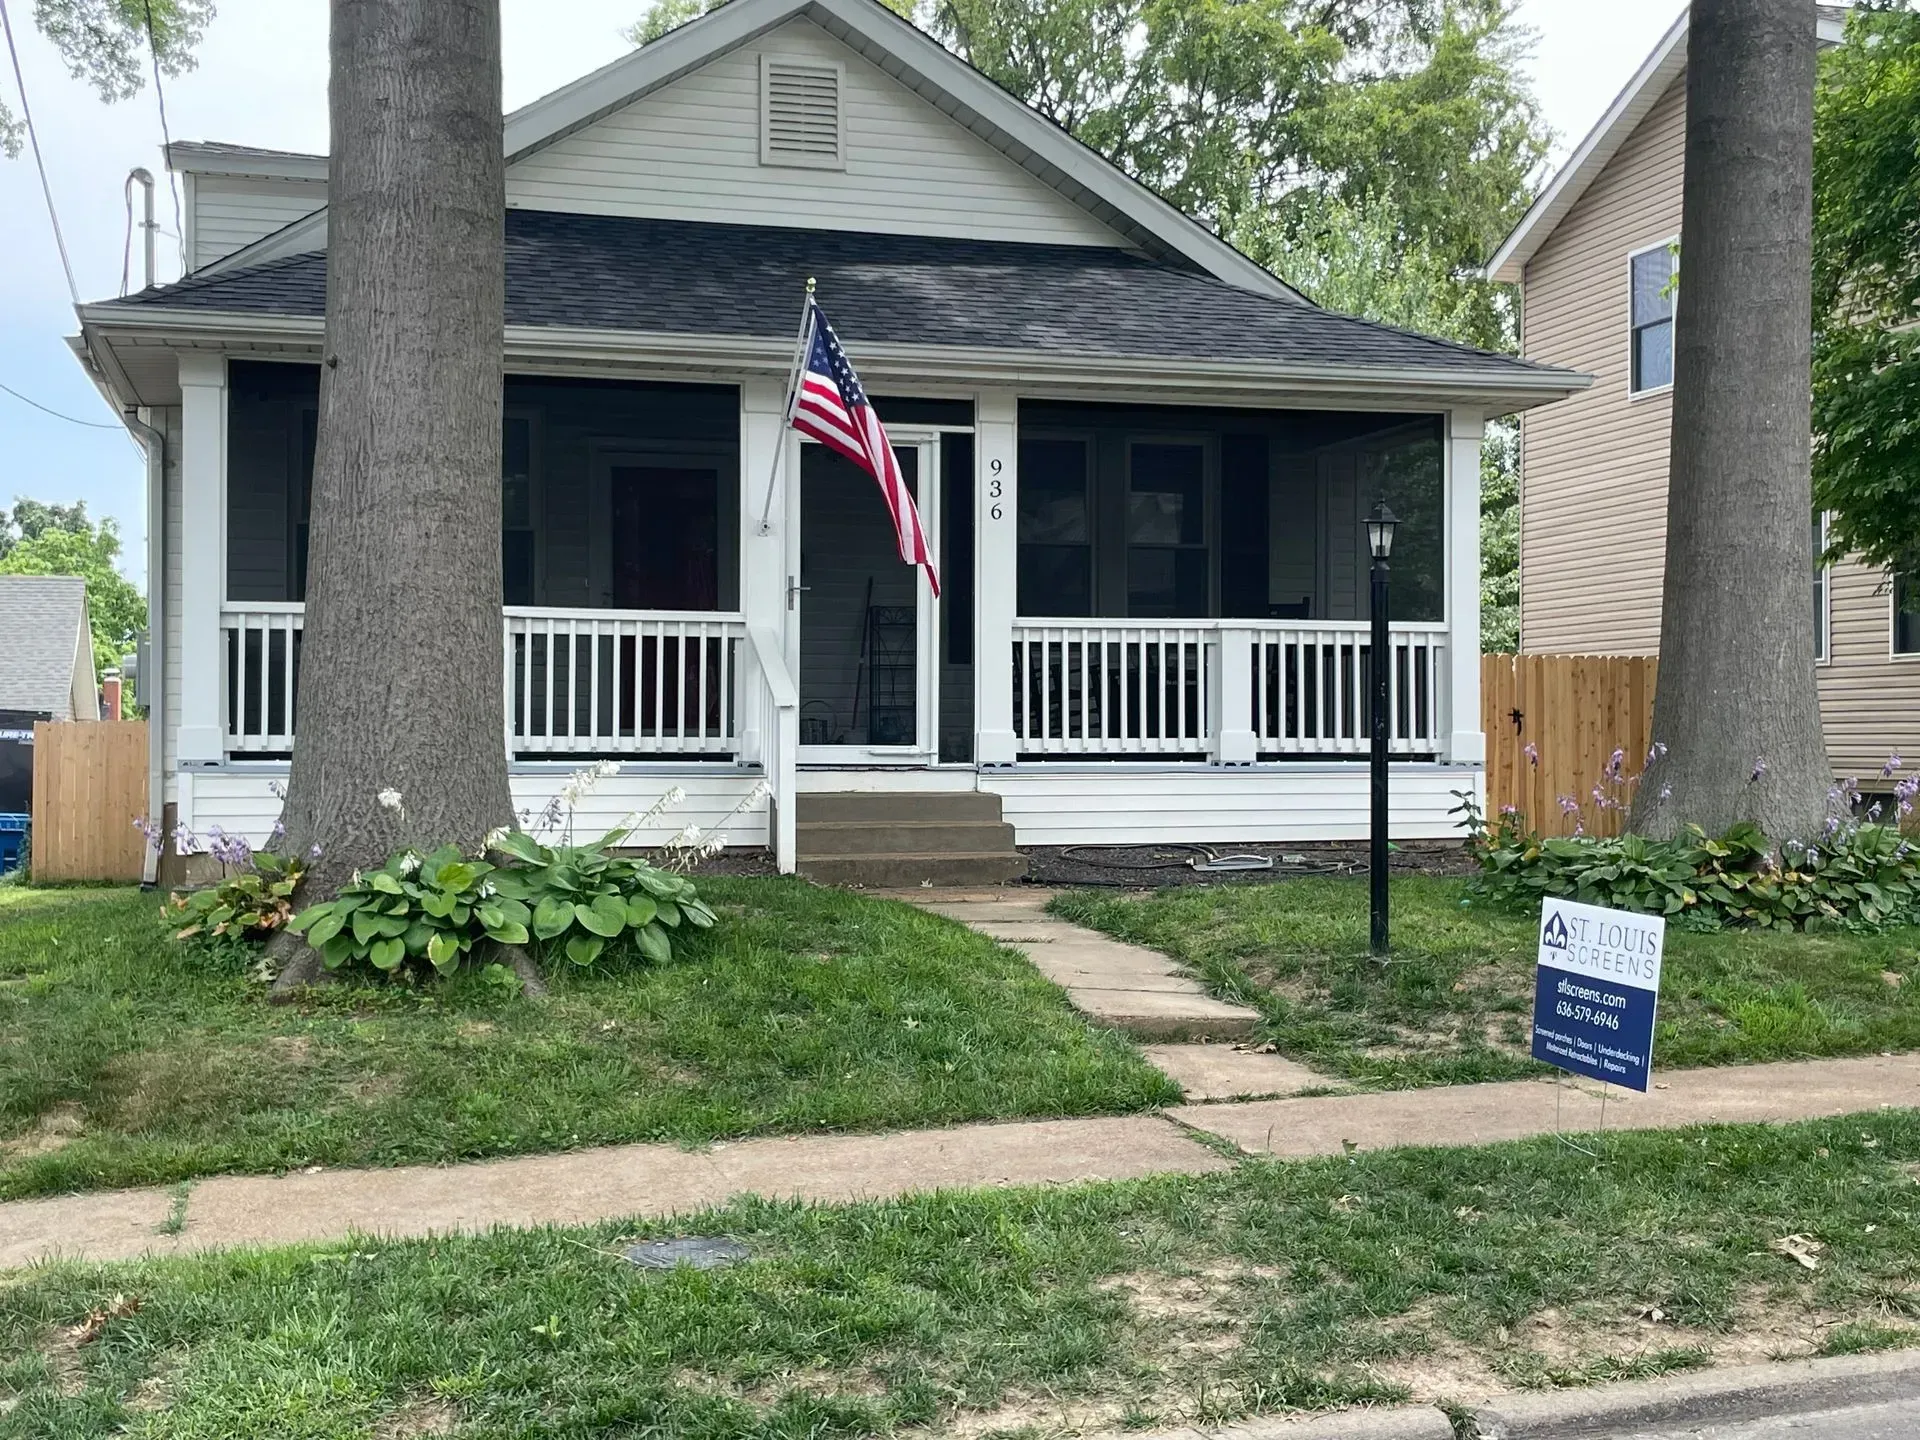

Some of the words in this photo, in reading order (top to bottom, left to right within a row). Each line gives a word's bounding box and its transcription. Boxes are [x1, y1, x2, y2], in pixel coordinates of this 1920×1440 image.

[989, 458, 1002, 520] 936
[1568, 916, 1592, 944] ST.
[1598, 922, 1657, 956] LOUIS
[1567, 942, 1655, 980] SCREENS
[1557, 977, 1627, 1010] stlscreens.com
[1556, 999, 1620, 1031] 636-579-6946
[1577, 1037, 1593, 1051] Doors
[1598, 1043, 1640, 1066] Underdecking
[1604, 1058, 1626, 1074] Repairs
